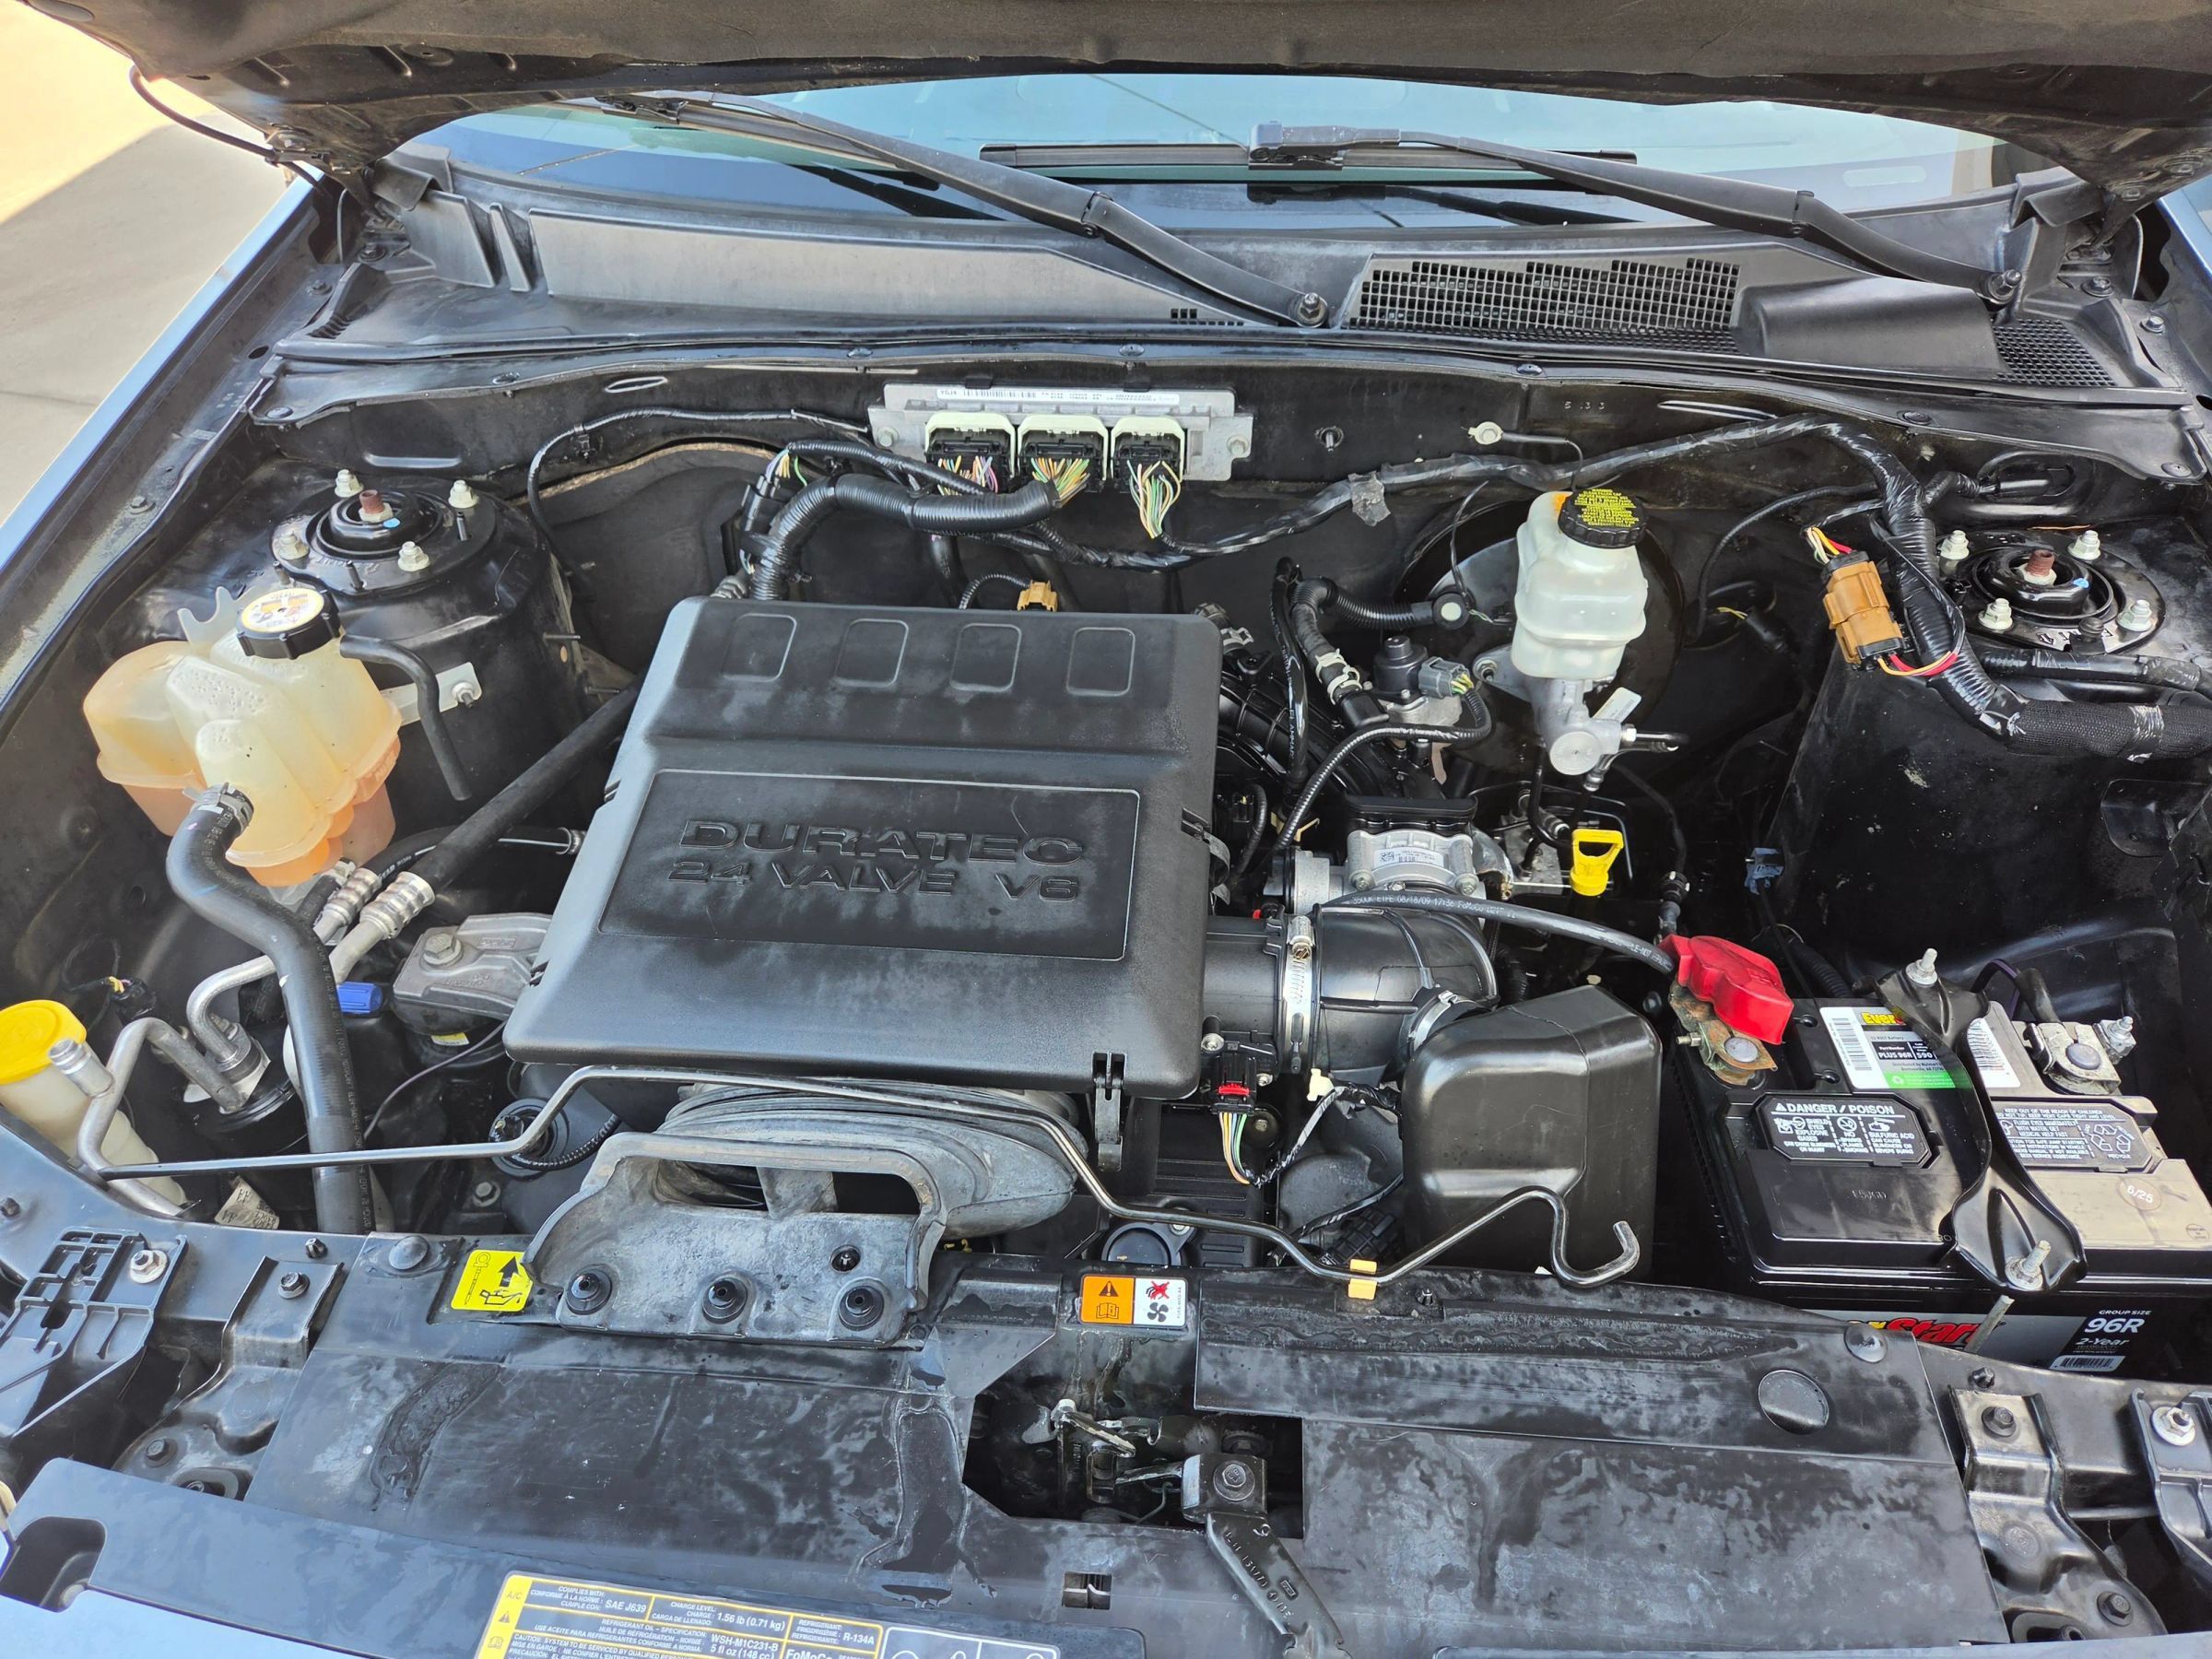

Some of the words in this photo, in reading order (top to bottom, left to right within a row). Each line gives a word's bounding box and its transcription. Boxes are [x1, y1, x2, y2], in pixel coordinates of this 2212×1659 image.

[678, 819, 1085, 866] DURATEC
[666, 859, 752, 886] 24
[771, 861, 958, 897] VALVE
[994, 871, 1081, 902] V6
[1787, 1102, 1838, 1113] DANGER
[1849, 1104, 1895, 1115] POISON
[2126, 1184, 2154, 1204] 6/25
[2084, 1317, 2146, 1334] 96R
[2076, 1337, 2131, 1346] 2-Year
[506, 1592, 523, 1600] A/C
[559, 1585, 589, 1595] COMPLIES
[605, 1599, 626, 1610] SAE
[625, 1601, 647, 1613] J639
[671, 1601, 697, 1611] CHARGE
[652, 1613, 670, 1621] CARGA
[717, 1612, 735, 1623] 1.56
[747, 1616, 769, 1629] (0.71
[770, 1618, 786, 1631] kg)
[601, 1618, 644, 1630] REFRIGERANT
[660, 1626, 707, 1639] SPECIFICATION:
[514, 1634, 542, 1643] CAUTION:
[544, 1637, 570, 1646] SYSTEM
[588, 1643, 618, 1653] SERVICED
[547, 1626, 570, 1635] ACEITE
[570, 1629, 586, 1637] PARA
[586, 1631, 638, 1645] REFRIGERANTES
[638, 1639, 672, 1650] CONFORME
[842, 1632, 876, 1645] R-134A
[535, 1643, 558, 1653] GARDE
[710, 1644, 717, 1653] 5
[726, 1647, 736, 1655] oz
[738, 1646, 758, 1659] (148
